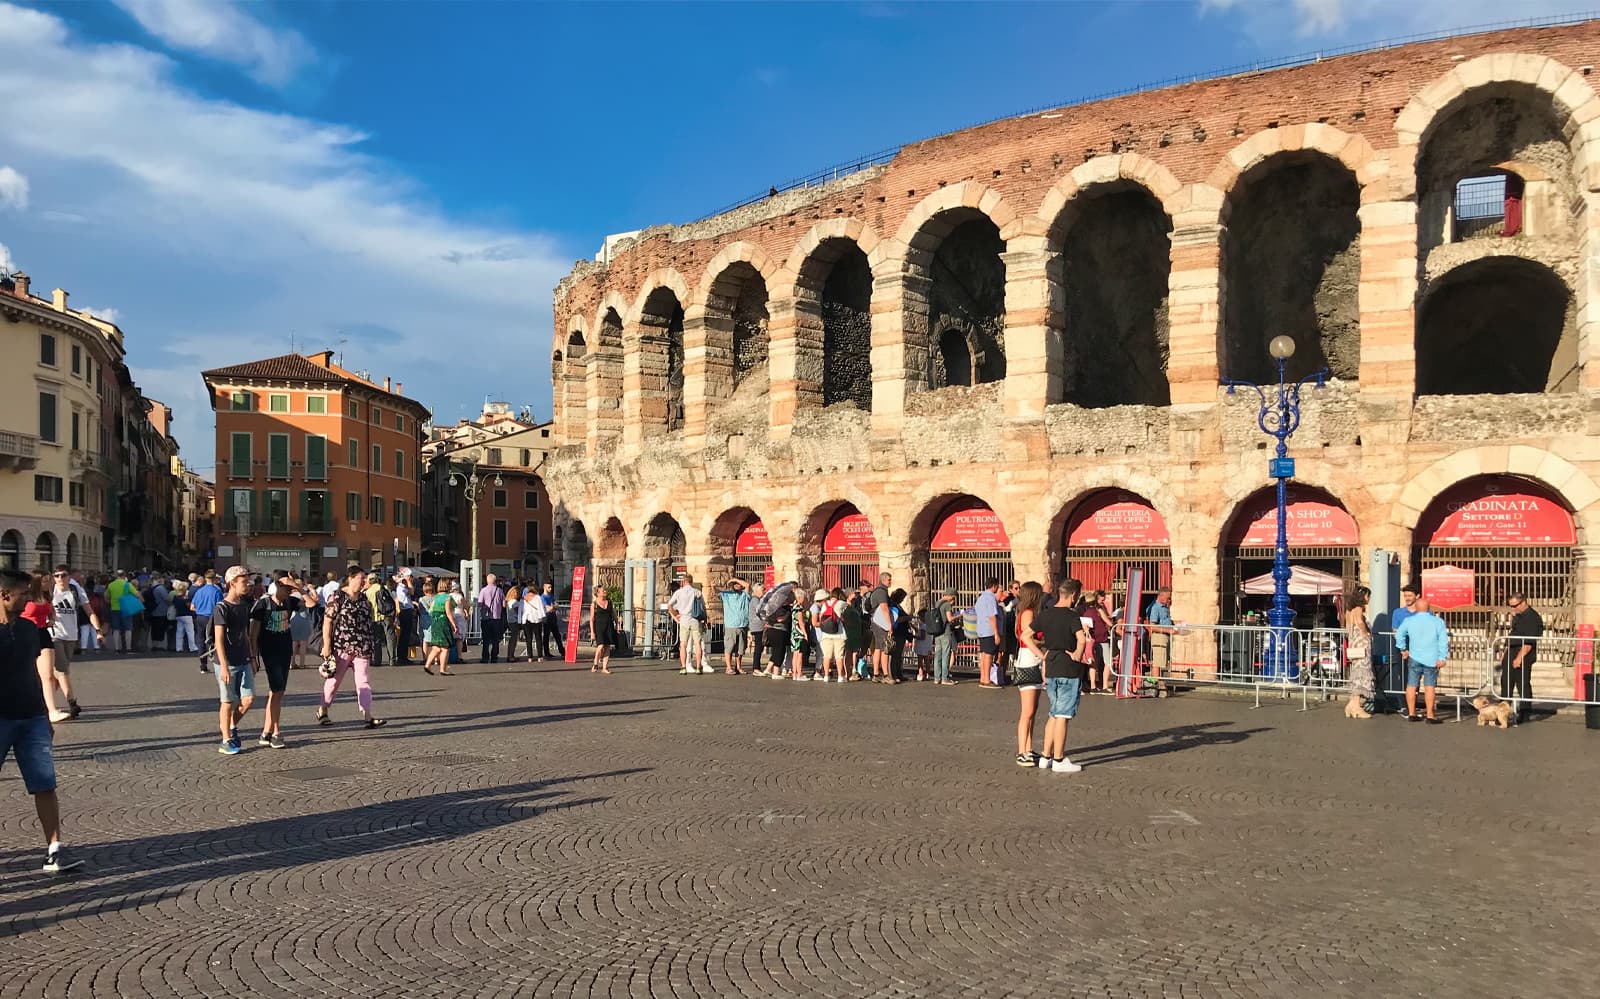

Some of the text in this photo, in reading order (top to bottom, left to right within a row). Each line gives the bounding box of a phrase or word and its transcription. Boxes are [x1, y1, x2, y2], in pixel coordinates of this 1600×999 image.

[1252, 510, 1330, 519] AREA SHOP
[955, 515, 999, 523] POLTRONE
[1297, 521, 1318, 529] Gate
